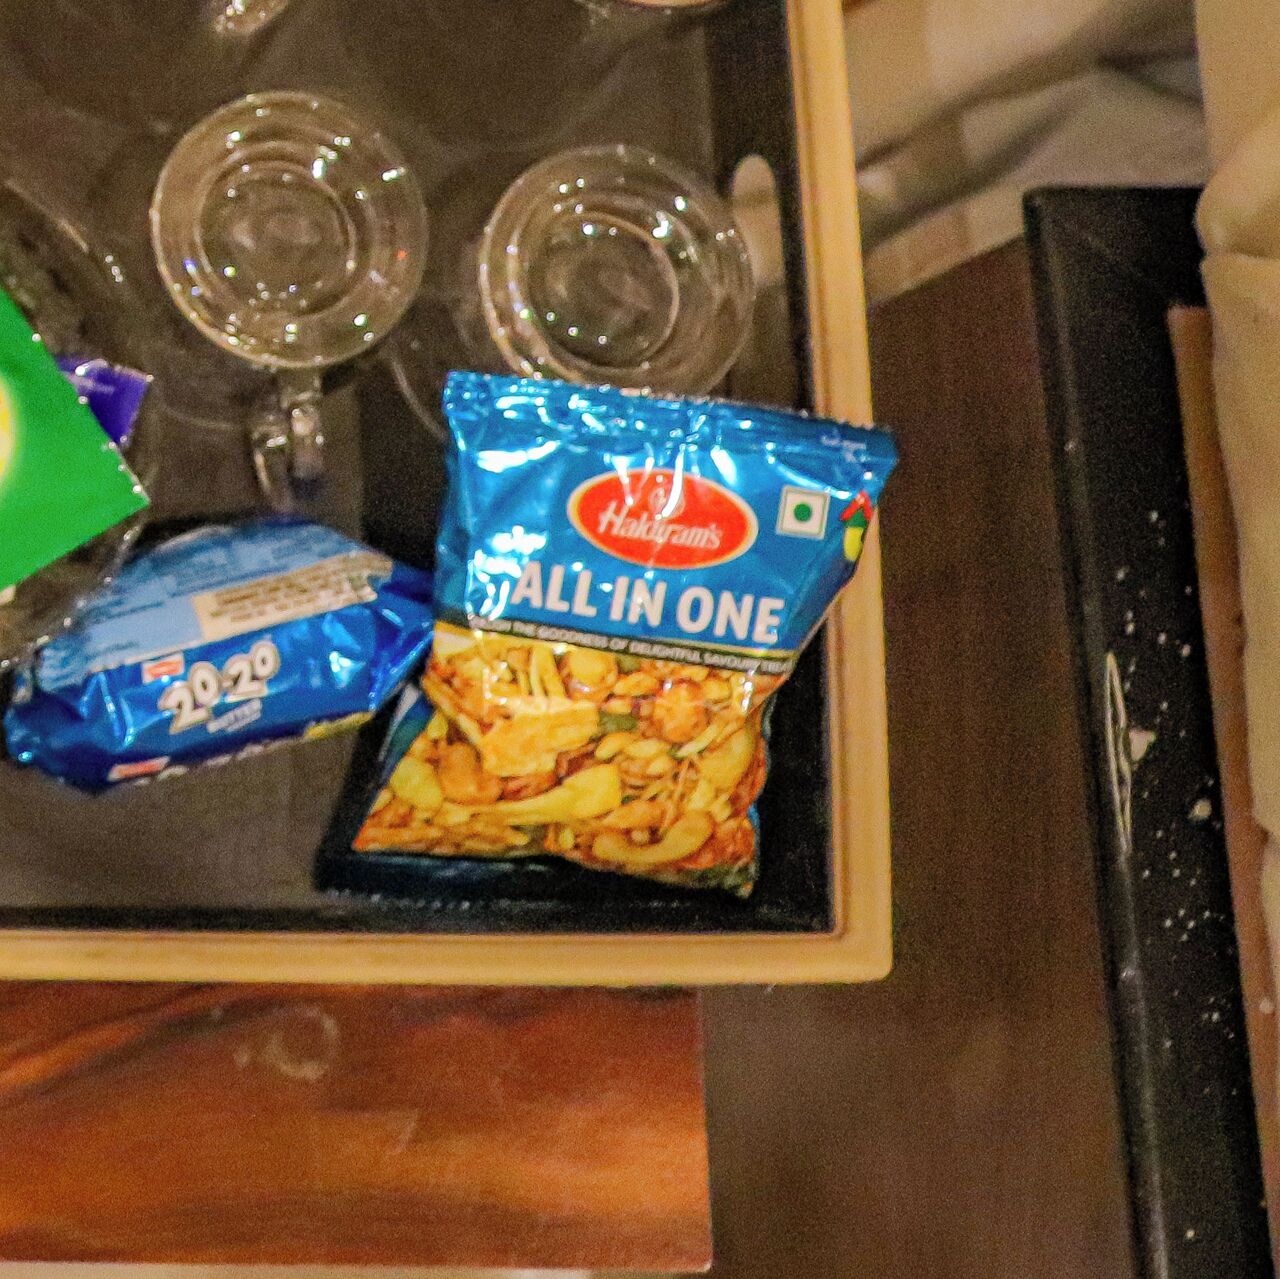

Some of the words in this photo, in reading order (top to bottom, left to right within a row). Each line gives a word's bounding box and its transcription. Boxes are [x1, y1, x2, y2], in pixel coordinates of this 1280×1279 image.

[509, 560, 598, 618] ALL
[609, 575, 668, 629] IN
[676, 585, 786, 645] ONE
